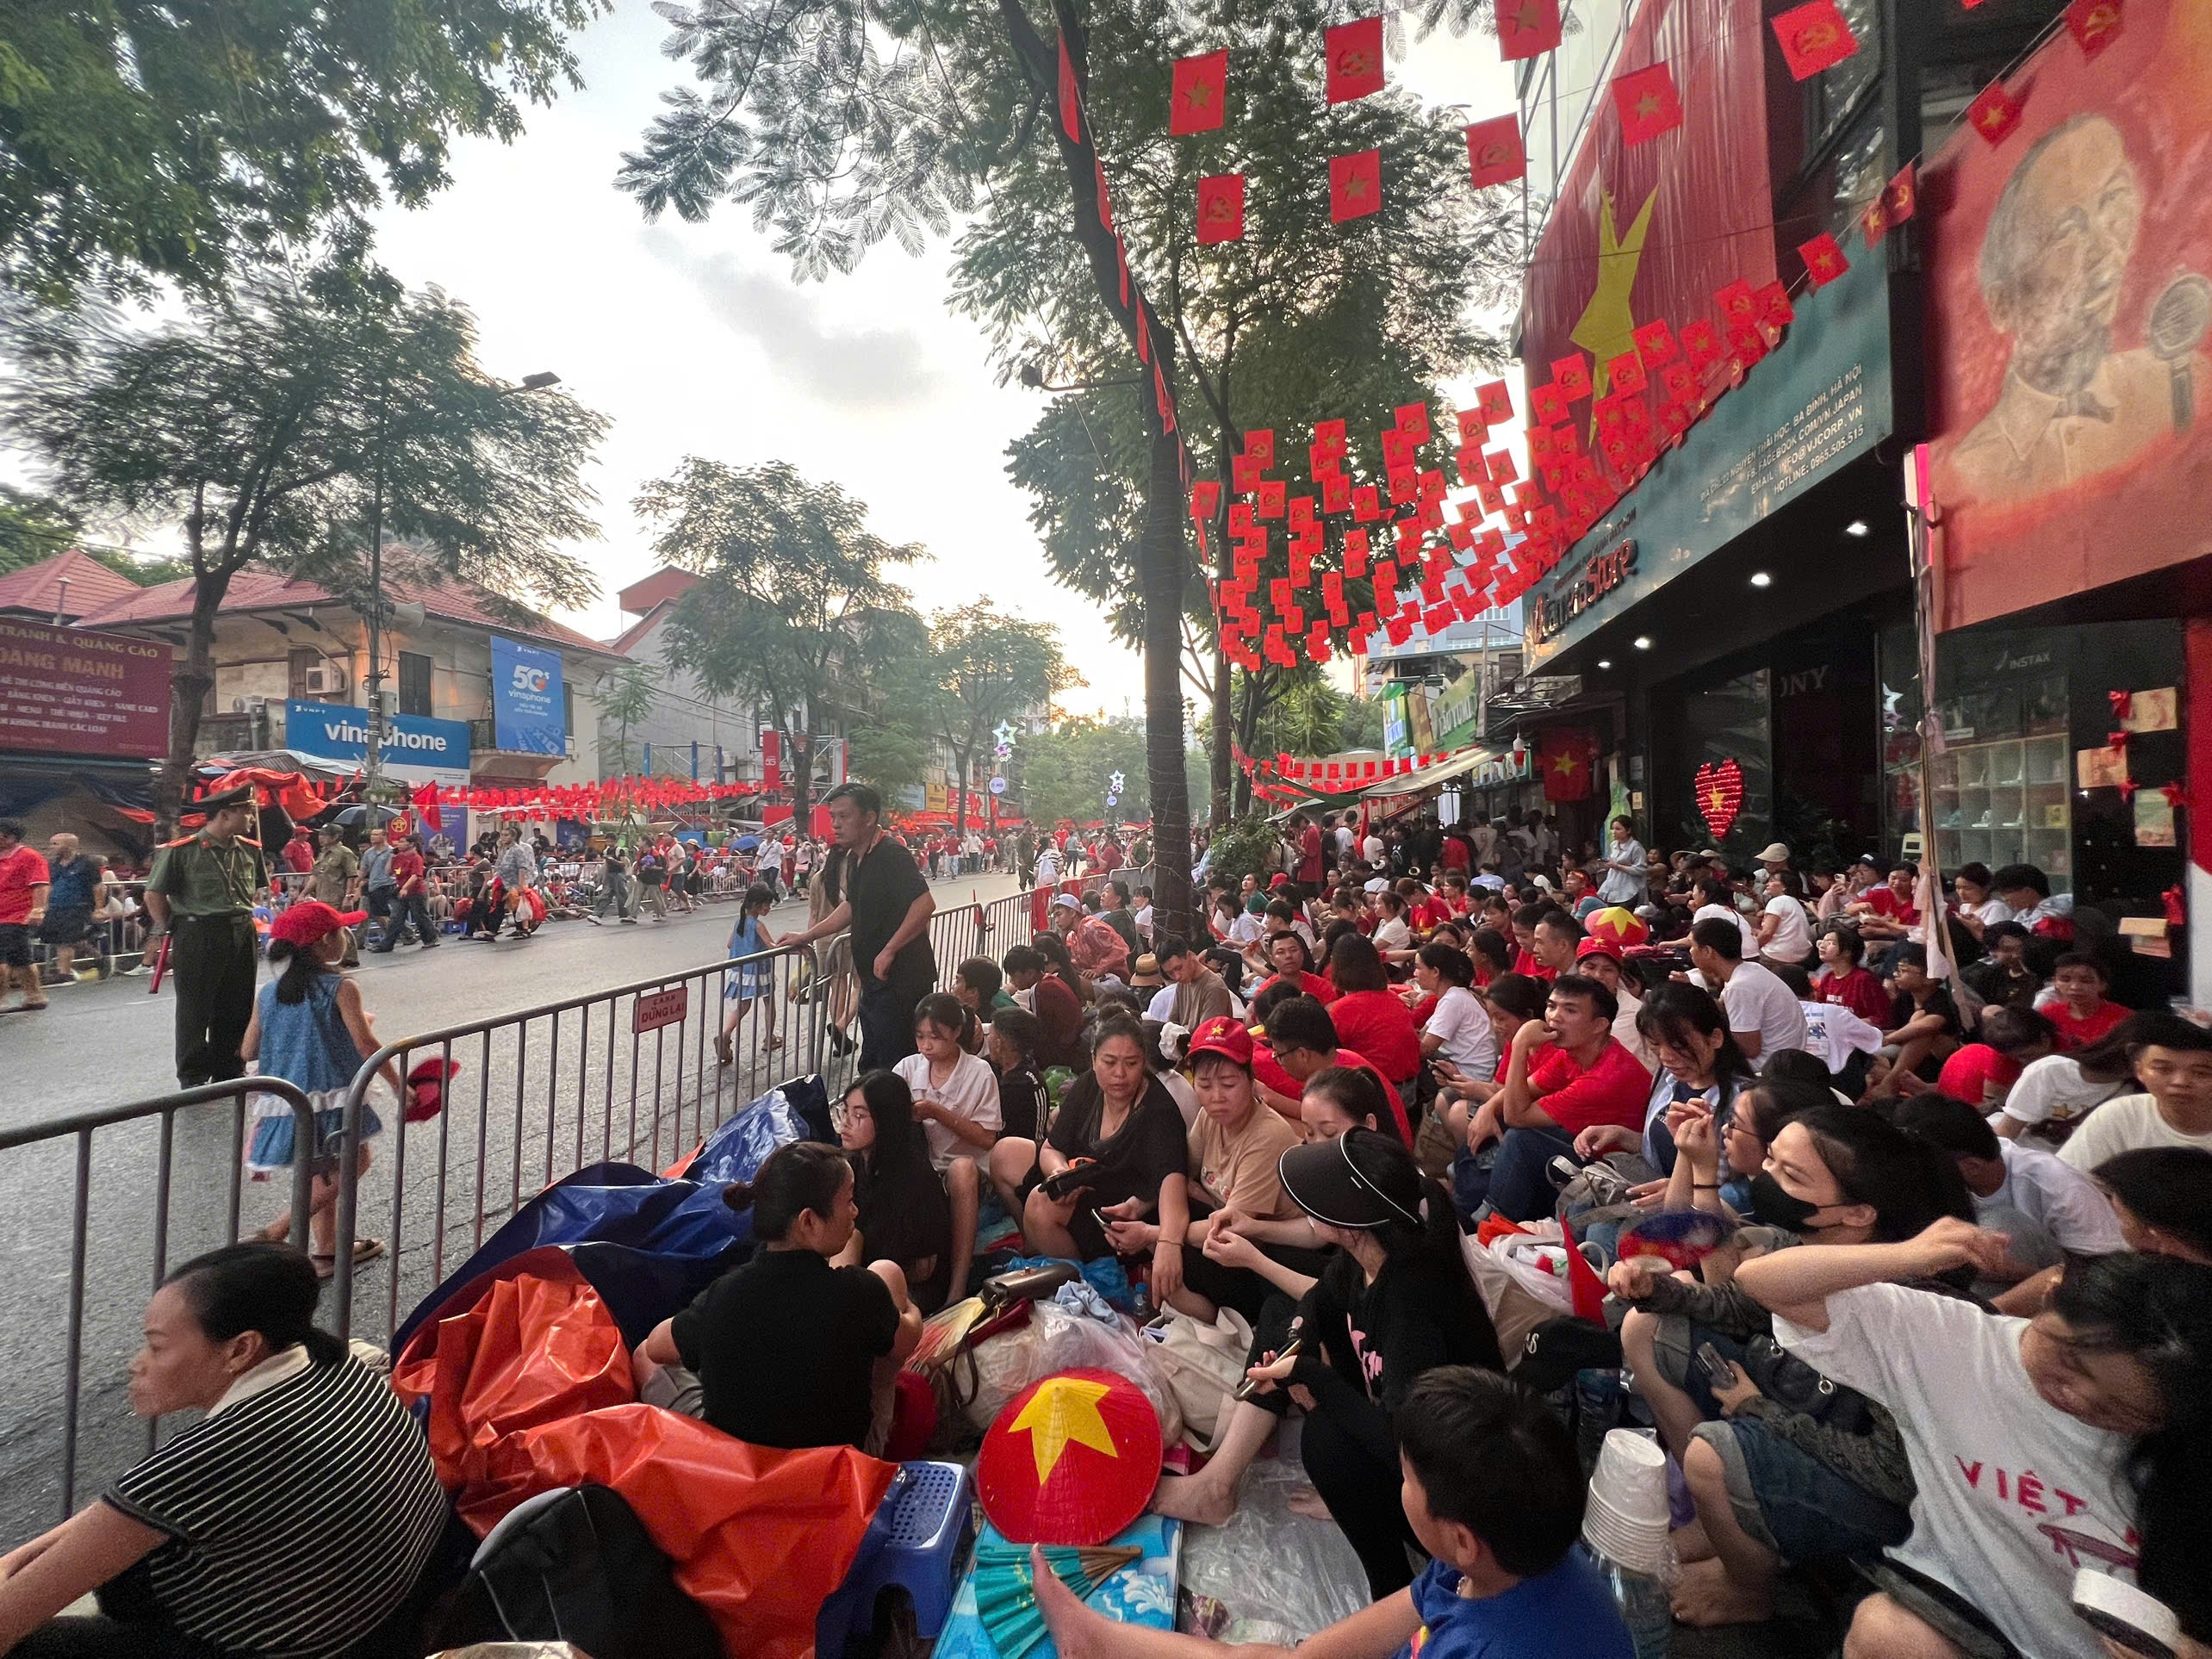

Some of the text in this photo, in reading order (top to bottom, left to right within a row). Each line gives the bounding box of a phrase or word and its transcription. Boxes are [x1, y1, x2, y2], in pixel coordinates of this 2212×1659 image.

[1830, 376, 1844, 397] HÀ
[1844, 362, 1862, 386] NỘI
[1848, 404, 1863, 423] VN
[1773, 423, 1865, 496] HOTLINE: 0965.505.515
[55, 633, 69, 645] &
[2009, 651, 2051, 670] INSTAX
[508, 689, 552, 704] vinaphone
[1954, 1453, 2089, 1519] VIỆT
